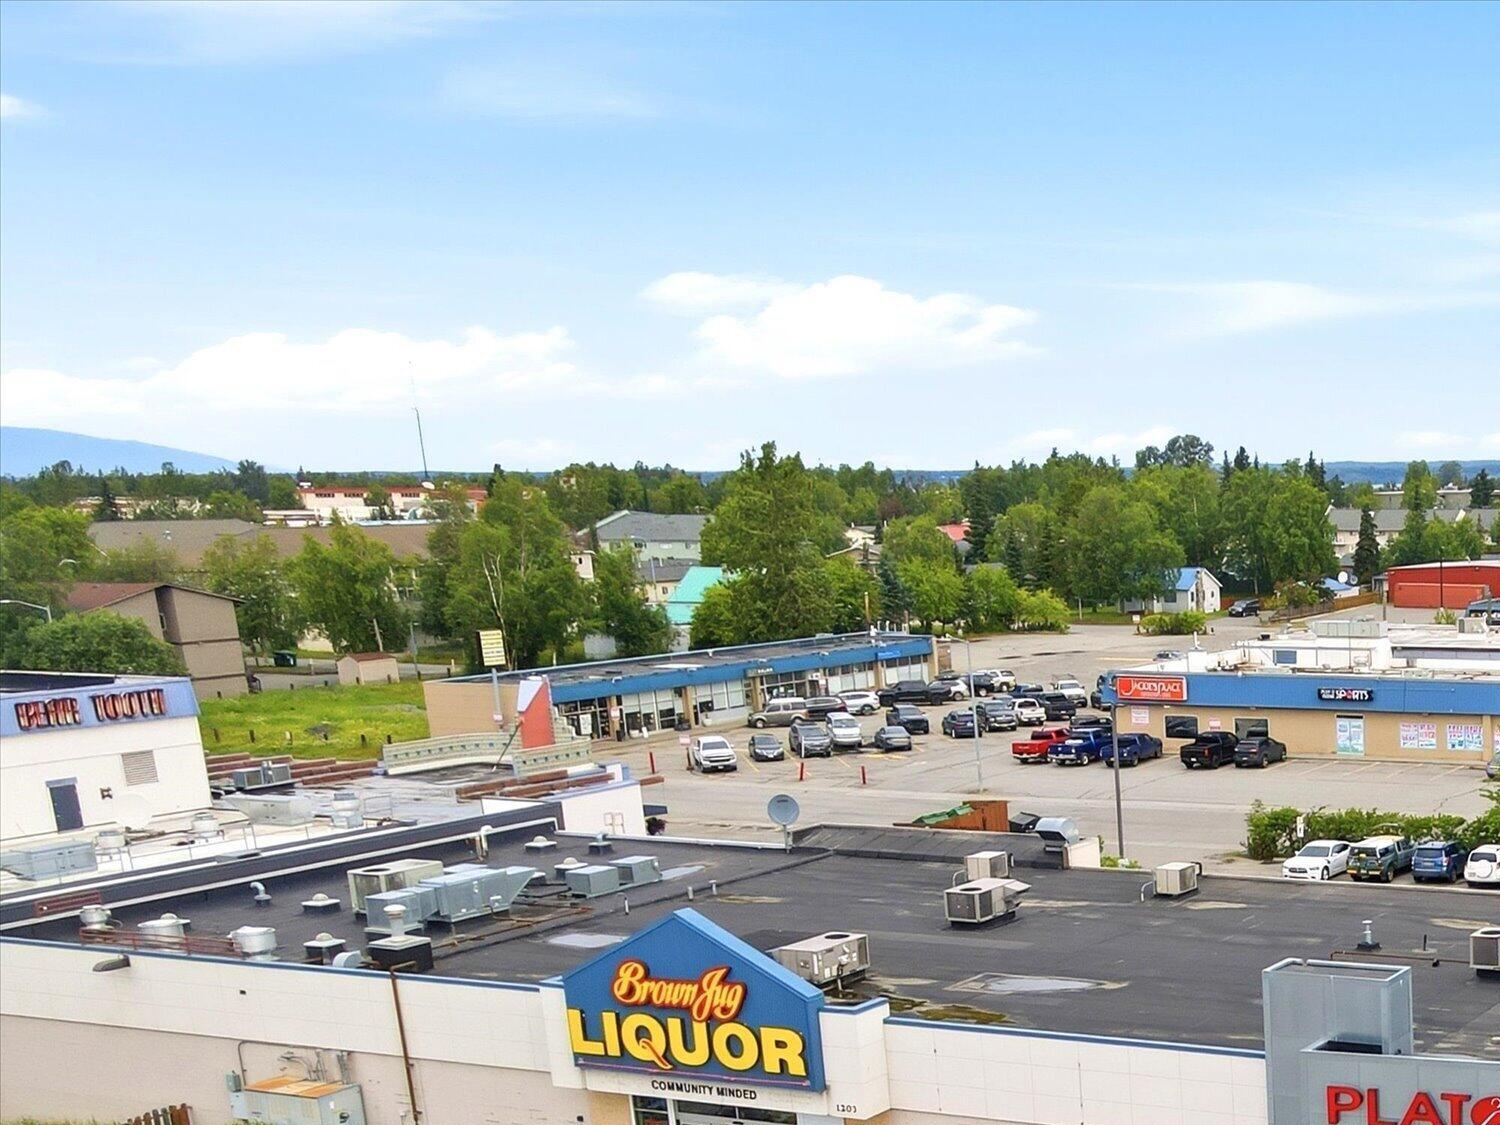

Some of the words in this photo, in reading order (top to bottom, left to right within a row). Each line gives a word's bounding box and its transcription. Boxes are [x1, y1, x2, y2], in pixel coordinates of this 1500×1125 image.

[1335, 689, 1369, 700] SPORTS
[613, 959, 697, 1009] Brown
[691, 966, 747, 1021] Jug
[567, 1008, 807, 1077] LIQUOR
[651, 1080, 713, 1095] COMMUNITY
[717, 1086, 757, 1100] MINDED
